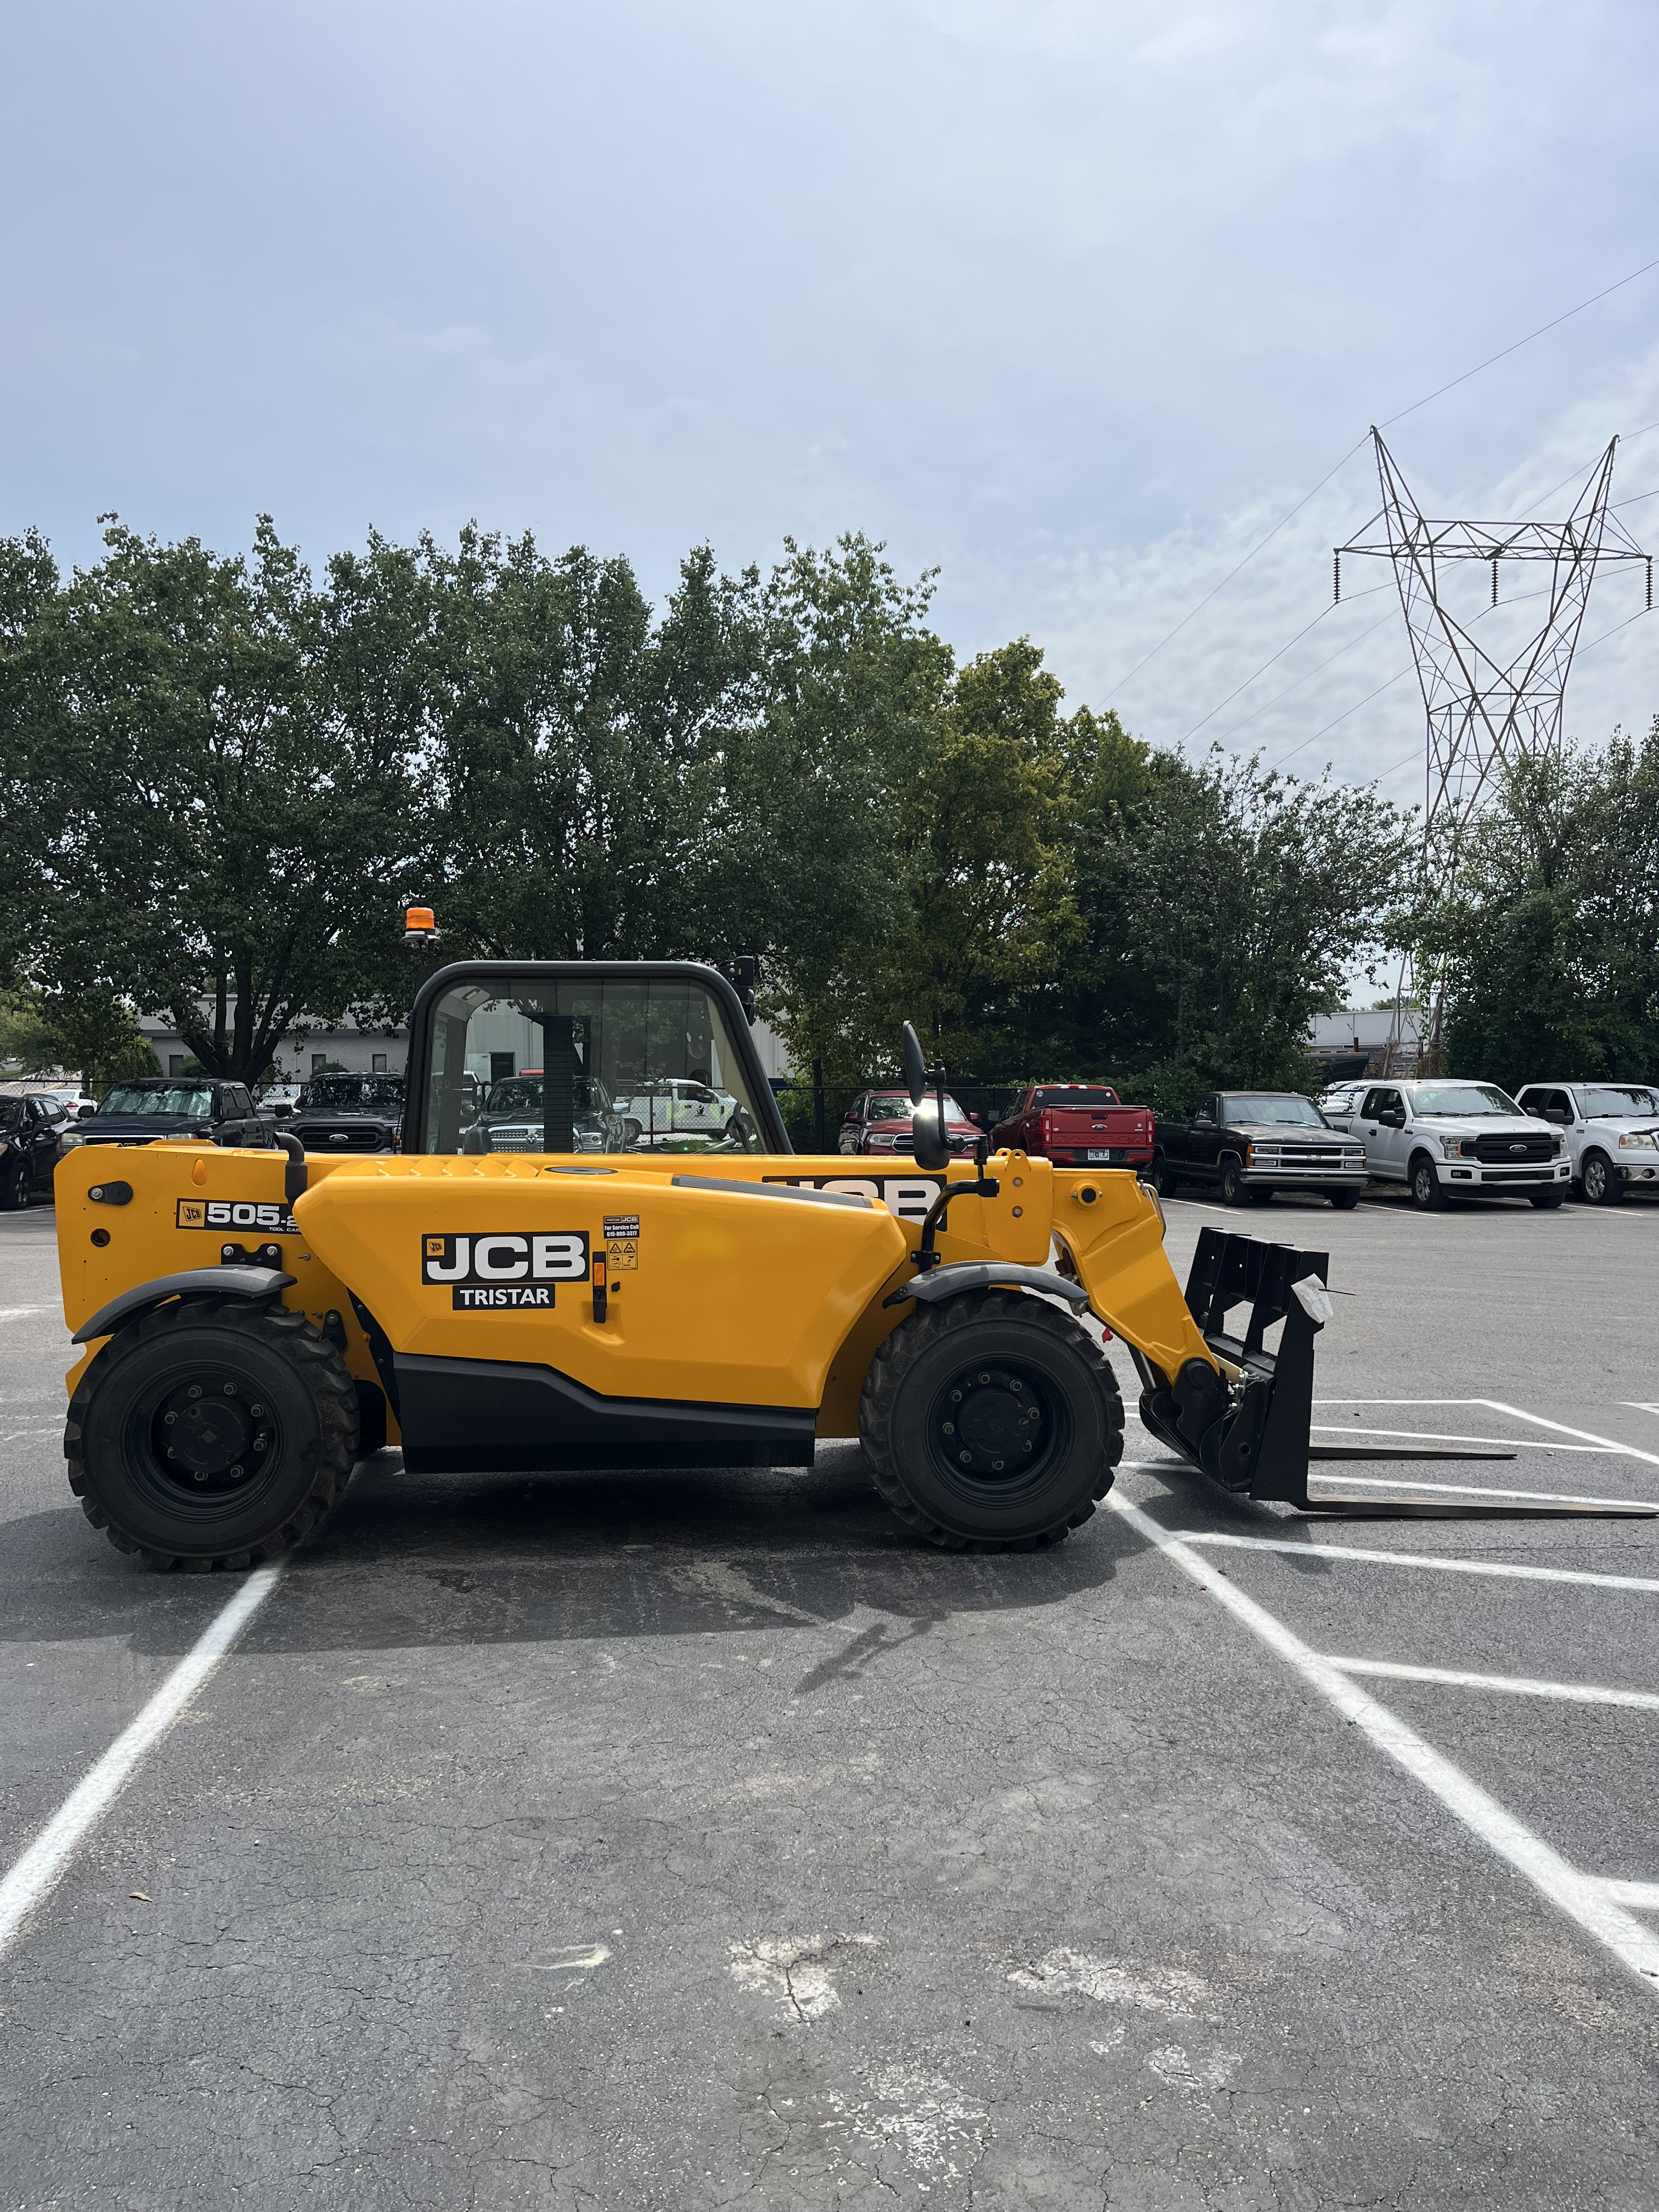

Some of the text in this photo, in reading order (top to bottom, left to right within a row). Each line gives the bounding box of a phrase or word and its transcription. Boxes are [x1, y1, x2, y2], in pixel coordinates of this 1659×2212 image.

[186, 1208, 200, 1220] JCB
[427, 1236, 586, 1280] JCB
[460, 1289, 550, 1305] TRISTAR
